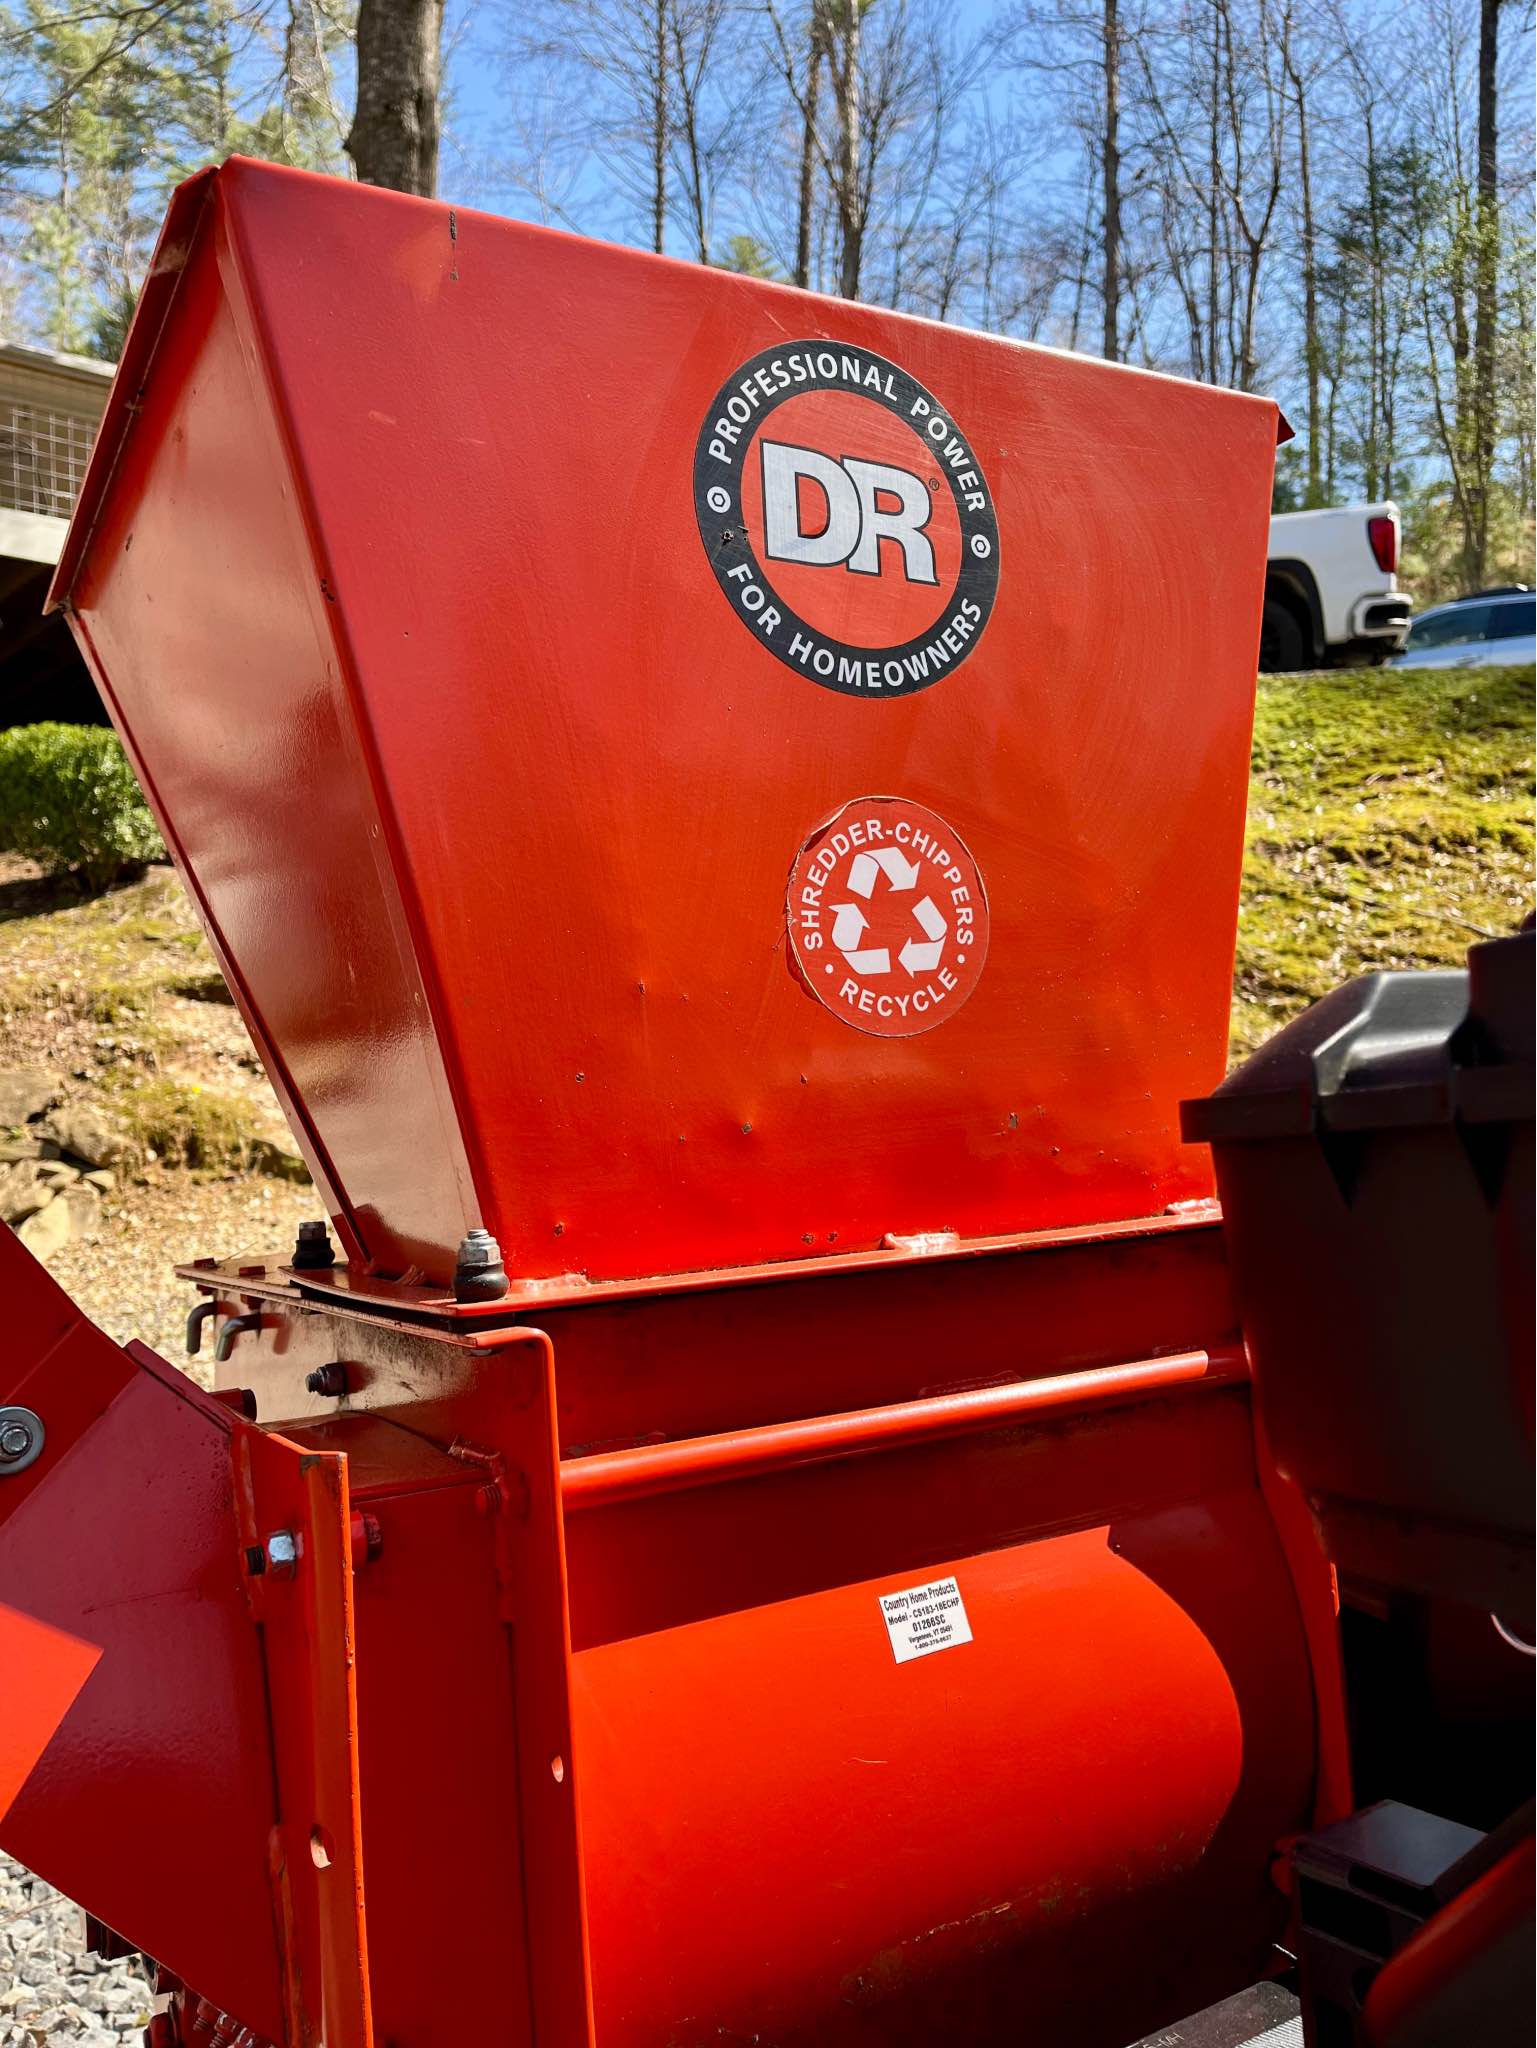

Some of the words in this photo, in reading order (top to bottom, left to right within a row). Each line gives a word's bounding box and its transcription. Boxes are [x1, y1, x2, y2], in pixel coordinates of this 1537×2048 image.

[708, 352, 898, 464] PROFESSIONAL
[910, 396, 985, 512] POWER
[727, 563, 781, 635] FOR
[788, 597, 982, 688] HOMEOWNERS
[801, 819, 974, 950] SHREDDER-CHIPPERS
[839, 967, 958, 1017] RECYCLE
[883, 1596, 909, 1611] Country
[909, 1592, 928, 1605] Home
[928, 1582, 956, 1597] Products
[888, 1612, 908, 1626] Model
